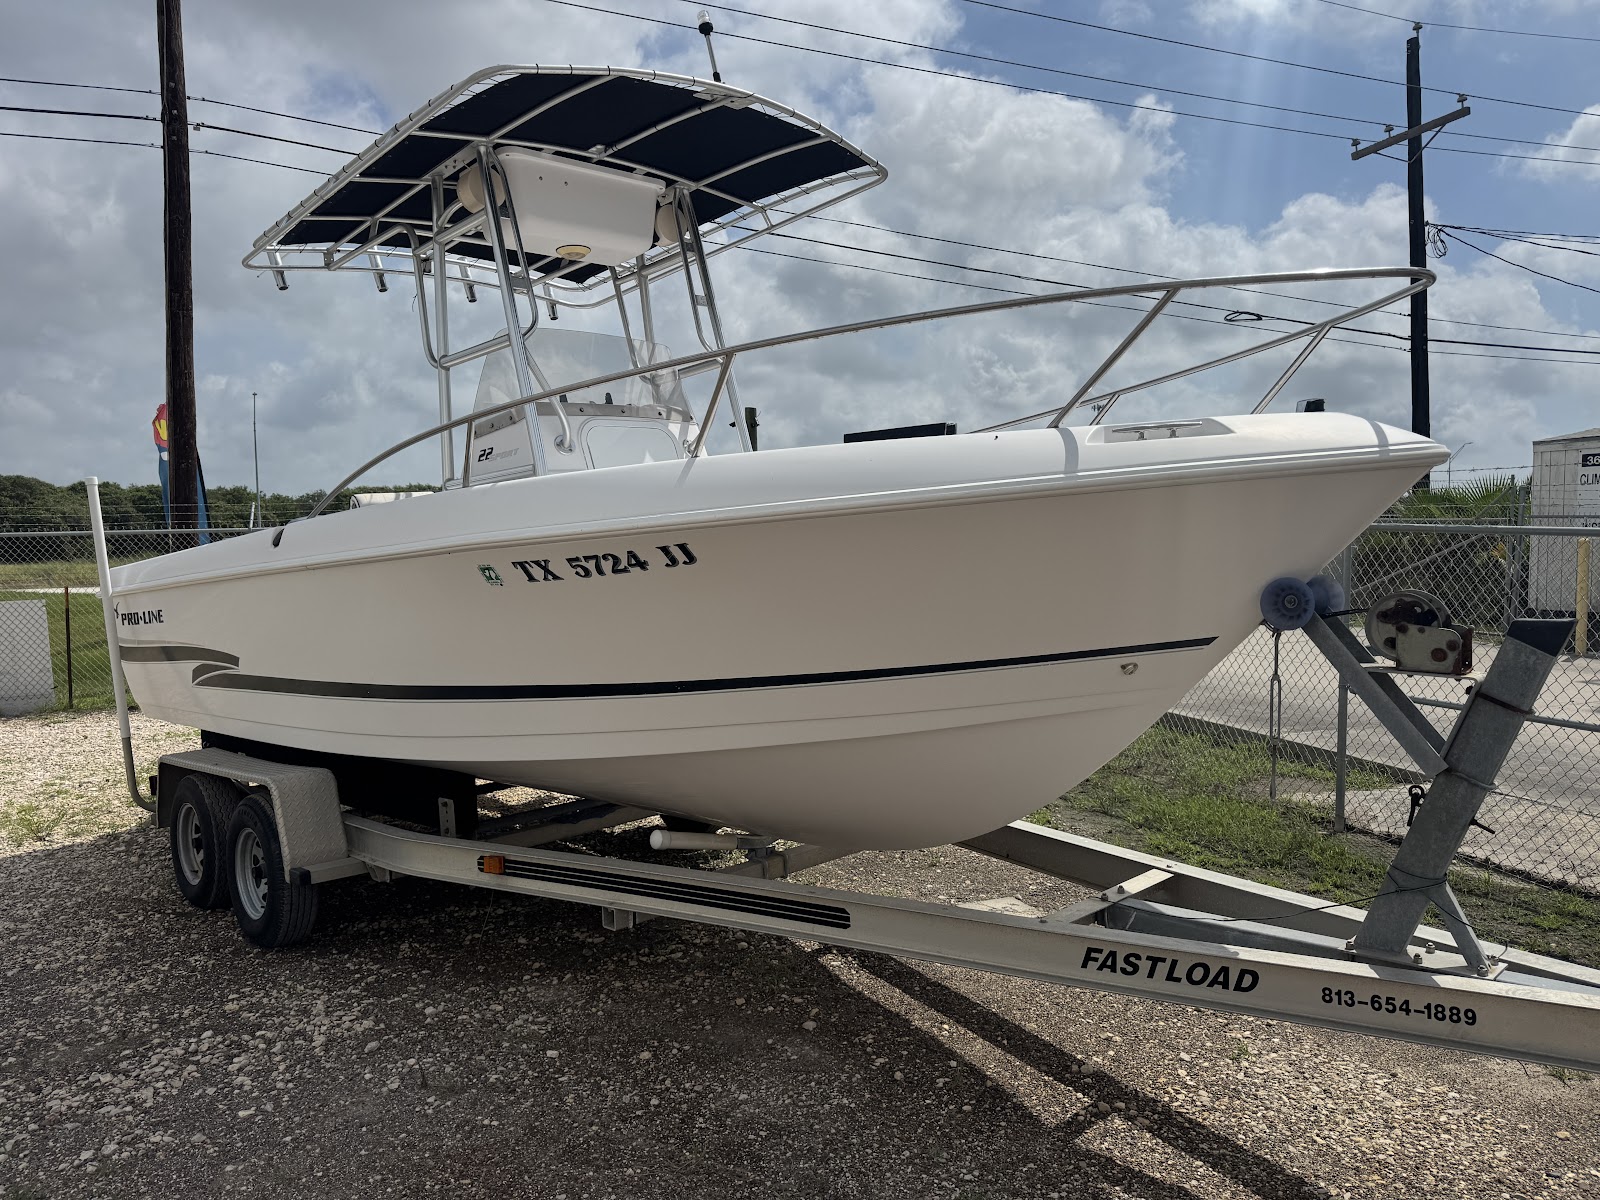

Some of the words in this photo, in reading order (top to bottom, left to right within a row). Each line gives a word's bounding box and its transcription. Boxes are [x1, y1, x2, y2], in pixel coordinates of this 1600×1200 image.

[478, 447, 493, 462] 22
[511, 559, 564, 583] TX
[565, 550, 649, 578] 5724
[655, 543, 697, 568] JJ
[1080, 946, 1260, 993] FASTLOAD
[1321, 986, 1477, 1026] 813-654-1889
